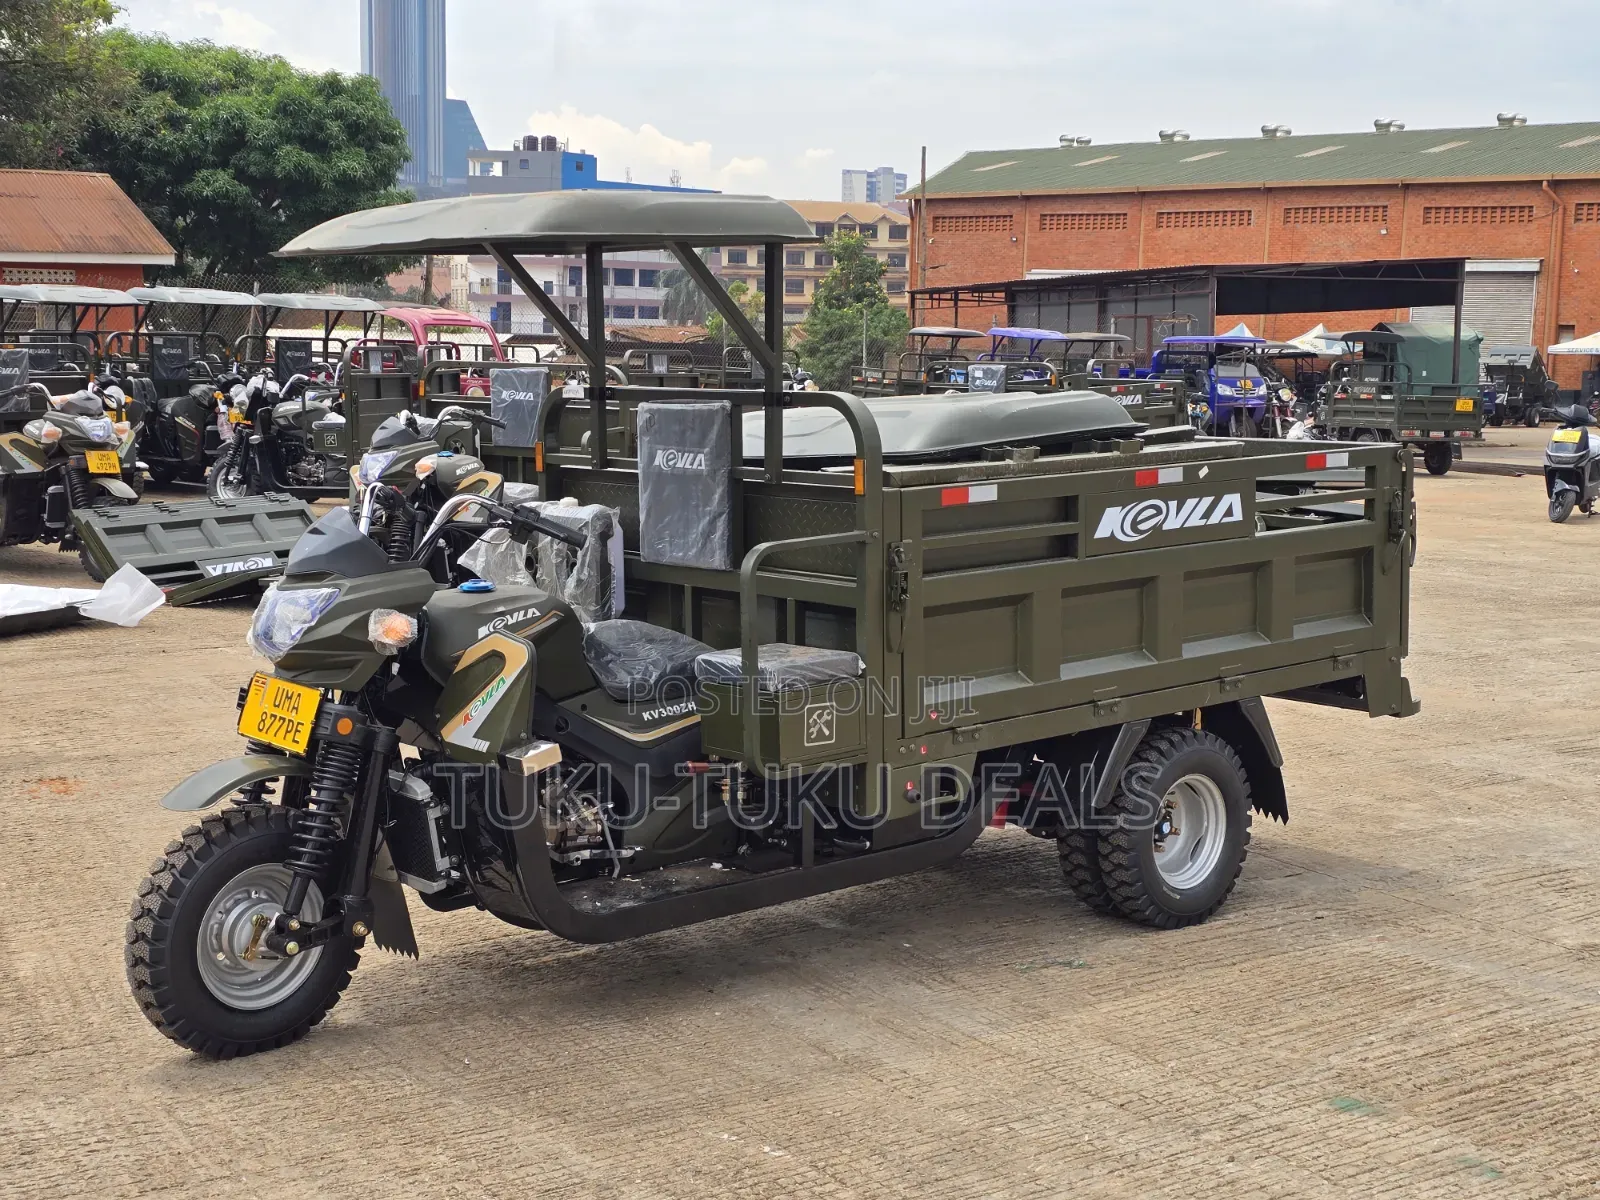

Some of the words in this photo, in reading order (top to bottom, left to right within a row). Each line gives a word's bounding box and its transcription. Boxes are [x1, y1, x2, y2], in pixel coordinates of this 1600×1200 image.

[97, 452, 111, 461] UMA
[272, 685, 302, 715] UMA
[641, 701, 697, 721] KV300ZH
[257, 711, 305, 745] 877PE
